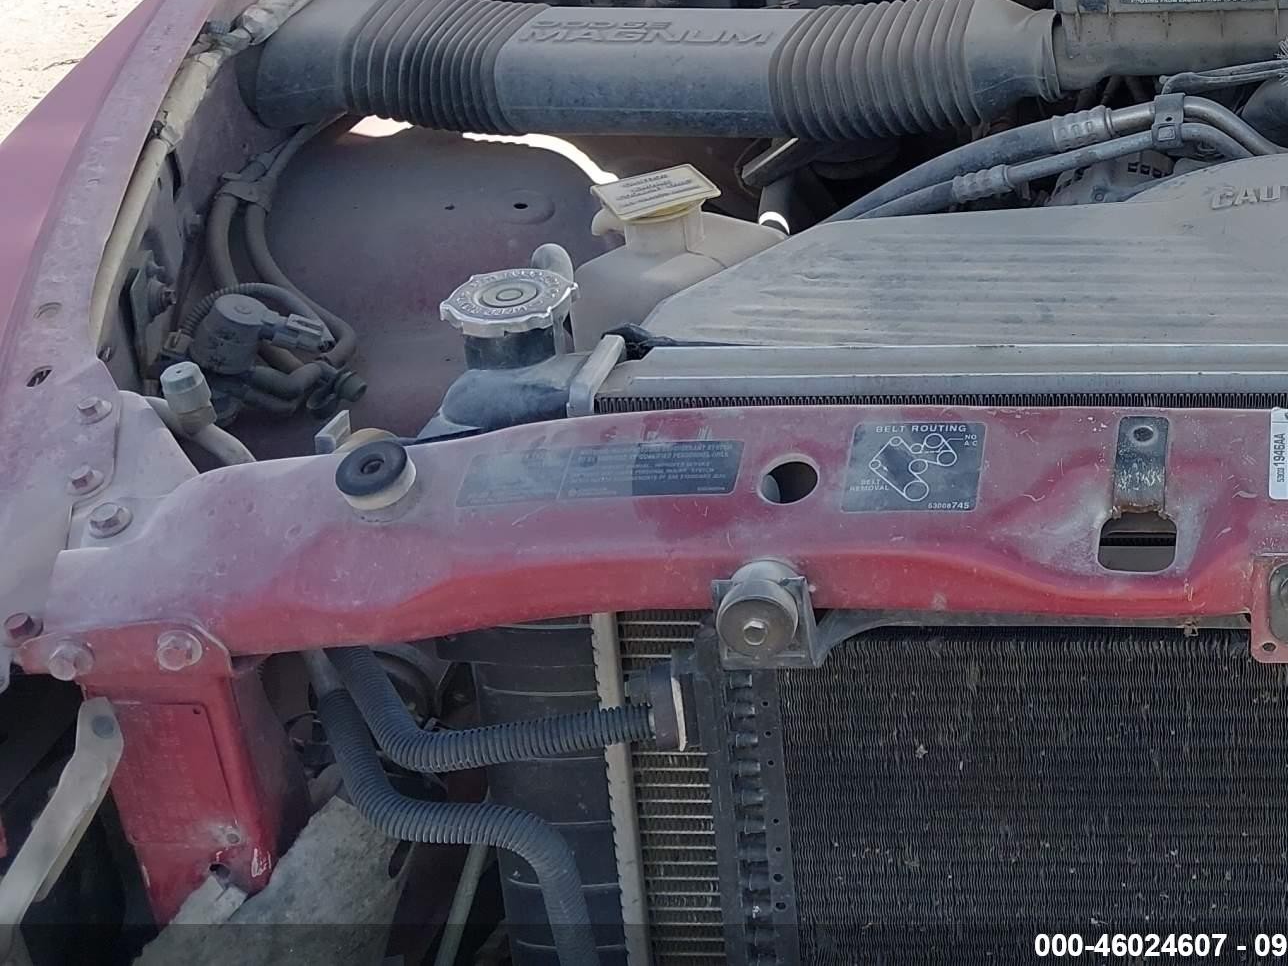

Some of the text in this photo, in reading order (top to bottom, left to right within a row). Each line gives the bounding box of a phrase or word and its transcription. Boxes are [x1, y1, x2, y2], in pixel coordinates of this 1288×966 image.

[531, 20, 672, 30] DODGE
[518, 28, 775, 47] MAGNUM
[875, 424, 967, 433] BELT ROUTING
